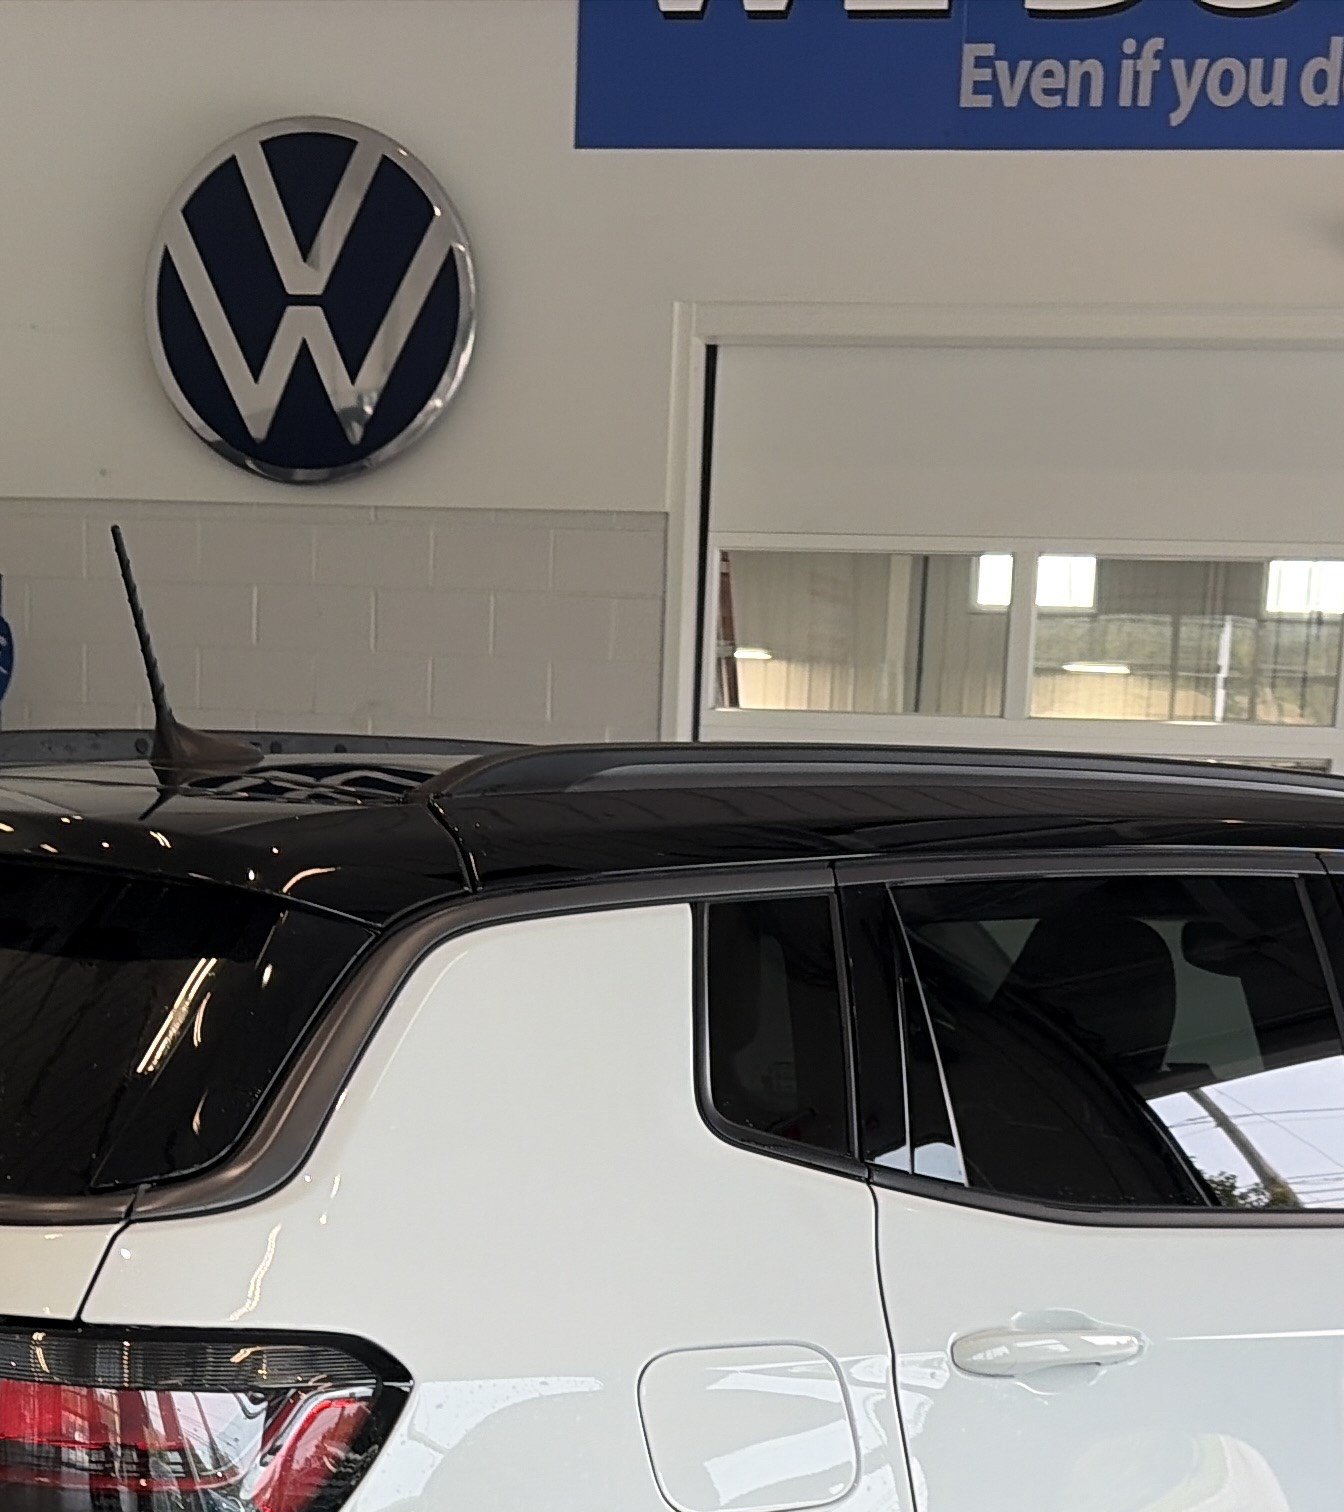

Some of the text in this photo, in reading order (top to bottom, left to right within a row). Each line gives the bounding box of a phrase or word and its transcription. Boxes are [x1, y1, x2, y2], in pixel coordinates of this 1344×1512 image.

[959, 43, 1104, 109] Even
[1118, 37, 1165, 107] if
[1169, 57, 1288, 127] you
[154, 125, 464, 450] VW
